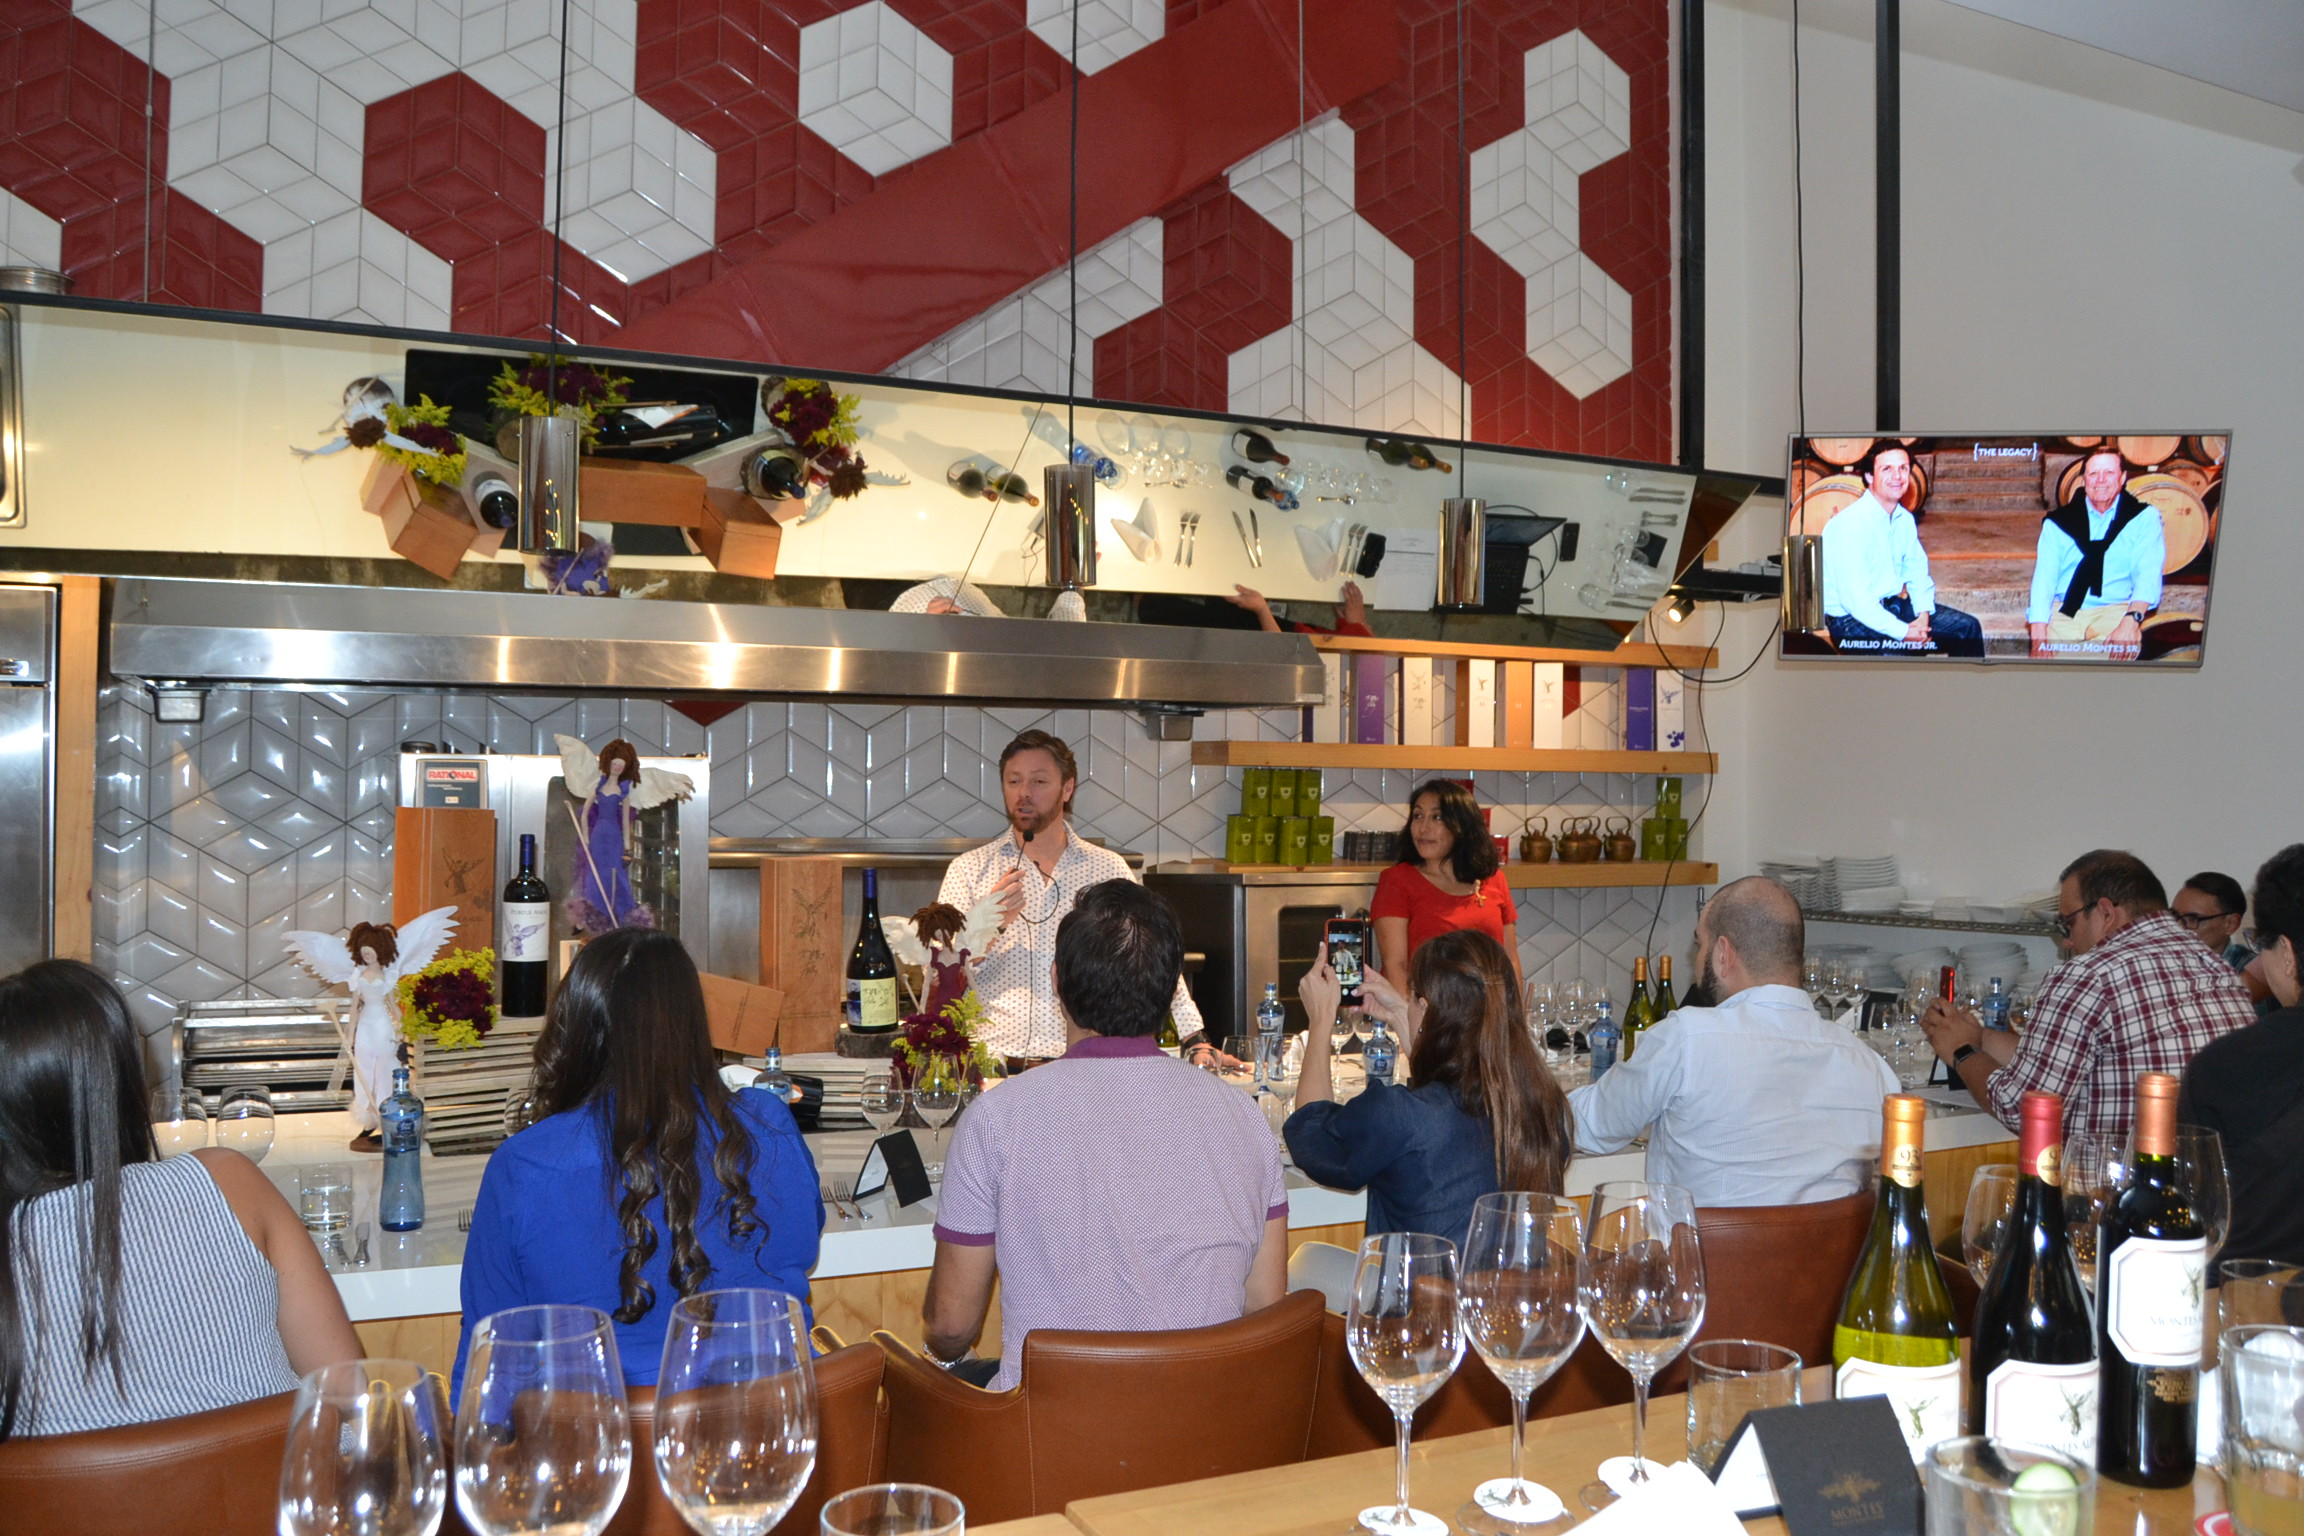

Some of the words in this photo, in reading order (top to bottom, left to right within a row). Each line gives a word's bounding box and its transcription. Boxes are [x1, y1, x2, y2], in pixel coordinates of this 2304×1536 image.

[1839, 639, 1880, 649] AURELIO
[1882, 640, 1923, 650] MONTES
[2038, 642, 2081, 652] AURELIO
[2083, 643, 2124, 653] MONTES
[428, 770, 476, 780] RATIONAL
